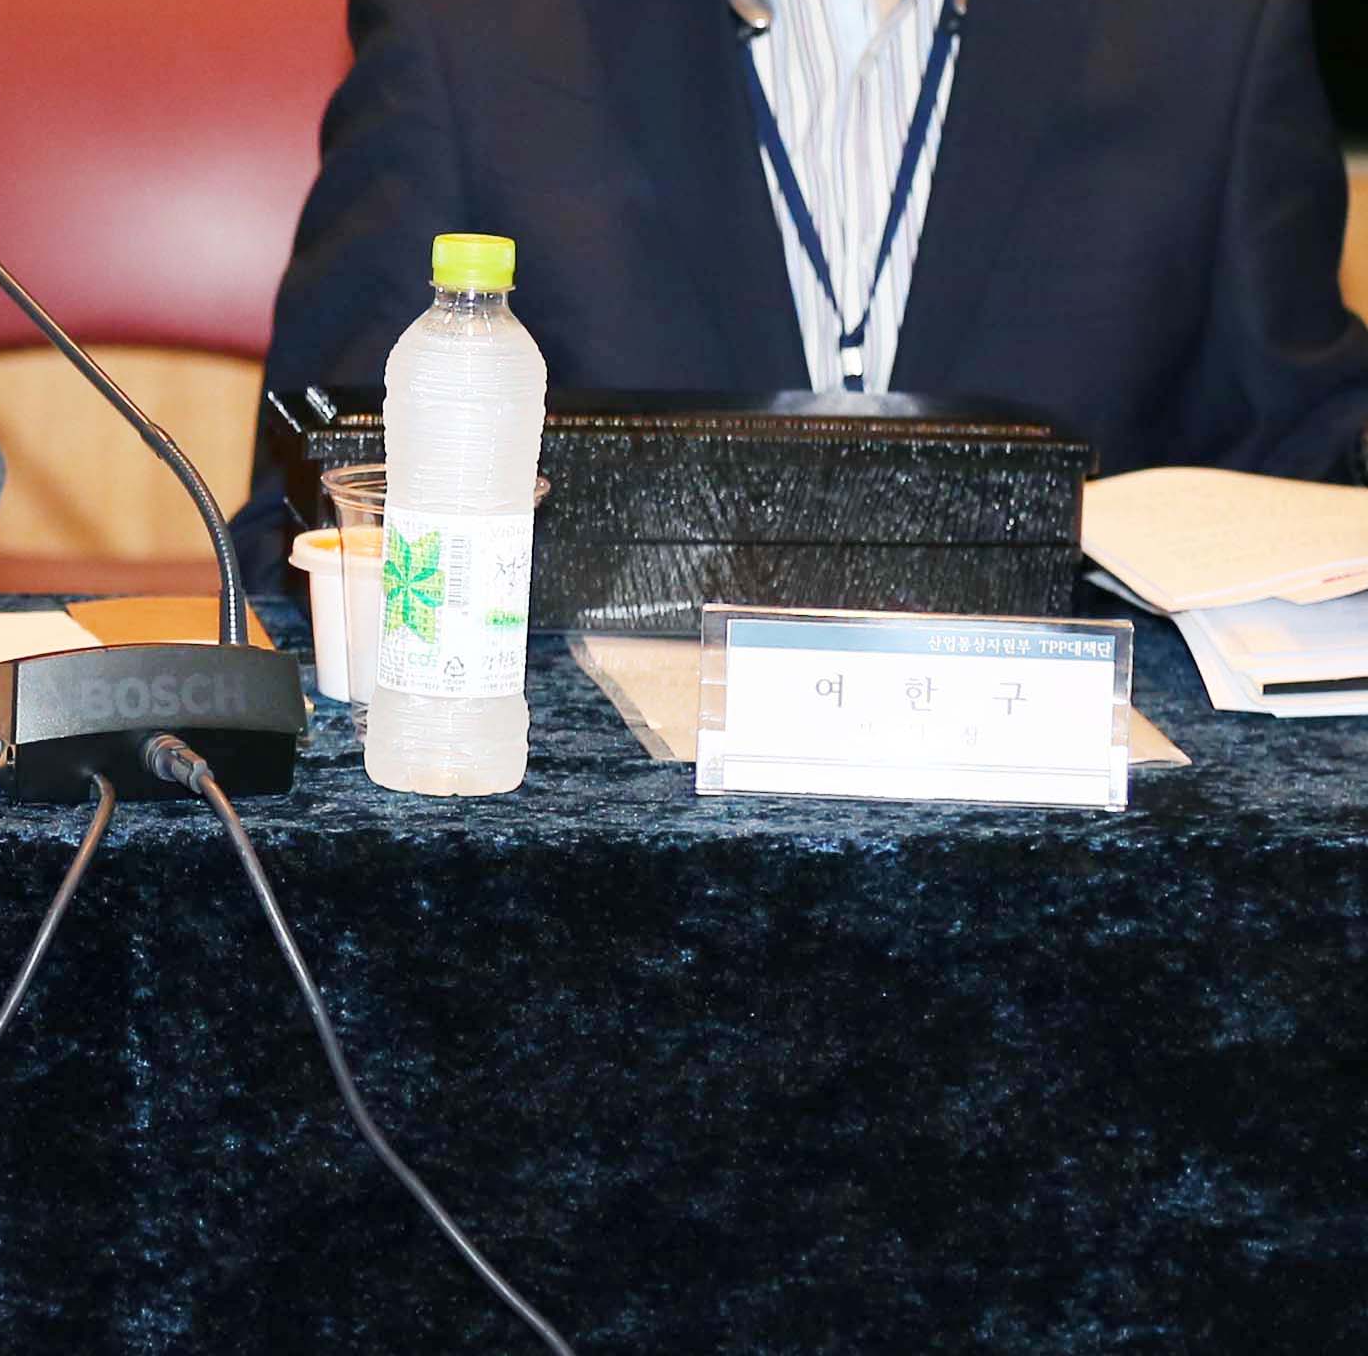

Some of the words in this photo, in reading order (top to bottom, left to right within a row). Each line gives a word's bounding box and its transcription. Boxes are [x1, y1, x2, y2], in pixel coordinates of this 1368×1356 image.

[927, 634, 1032, 656] 산업통상자원부
[1038, 638, 1113, 658] TPP대책단
[78, 672, 247, 720] BOSCH
